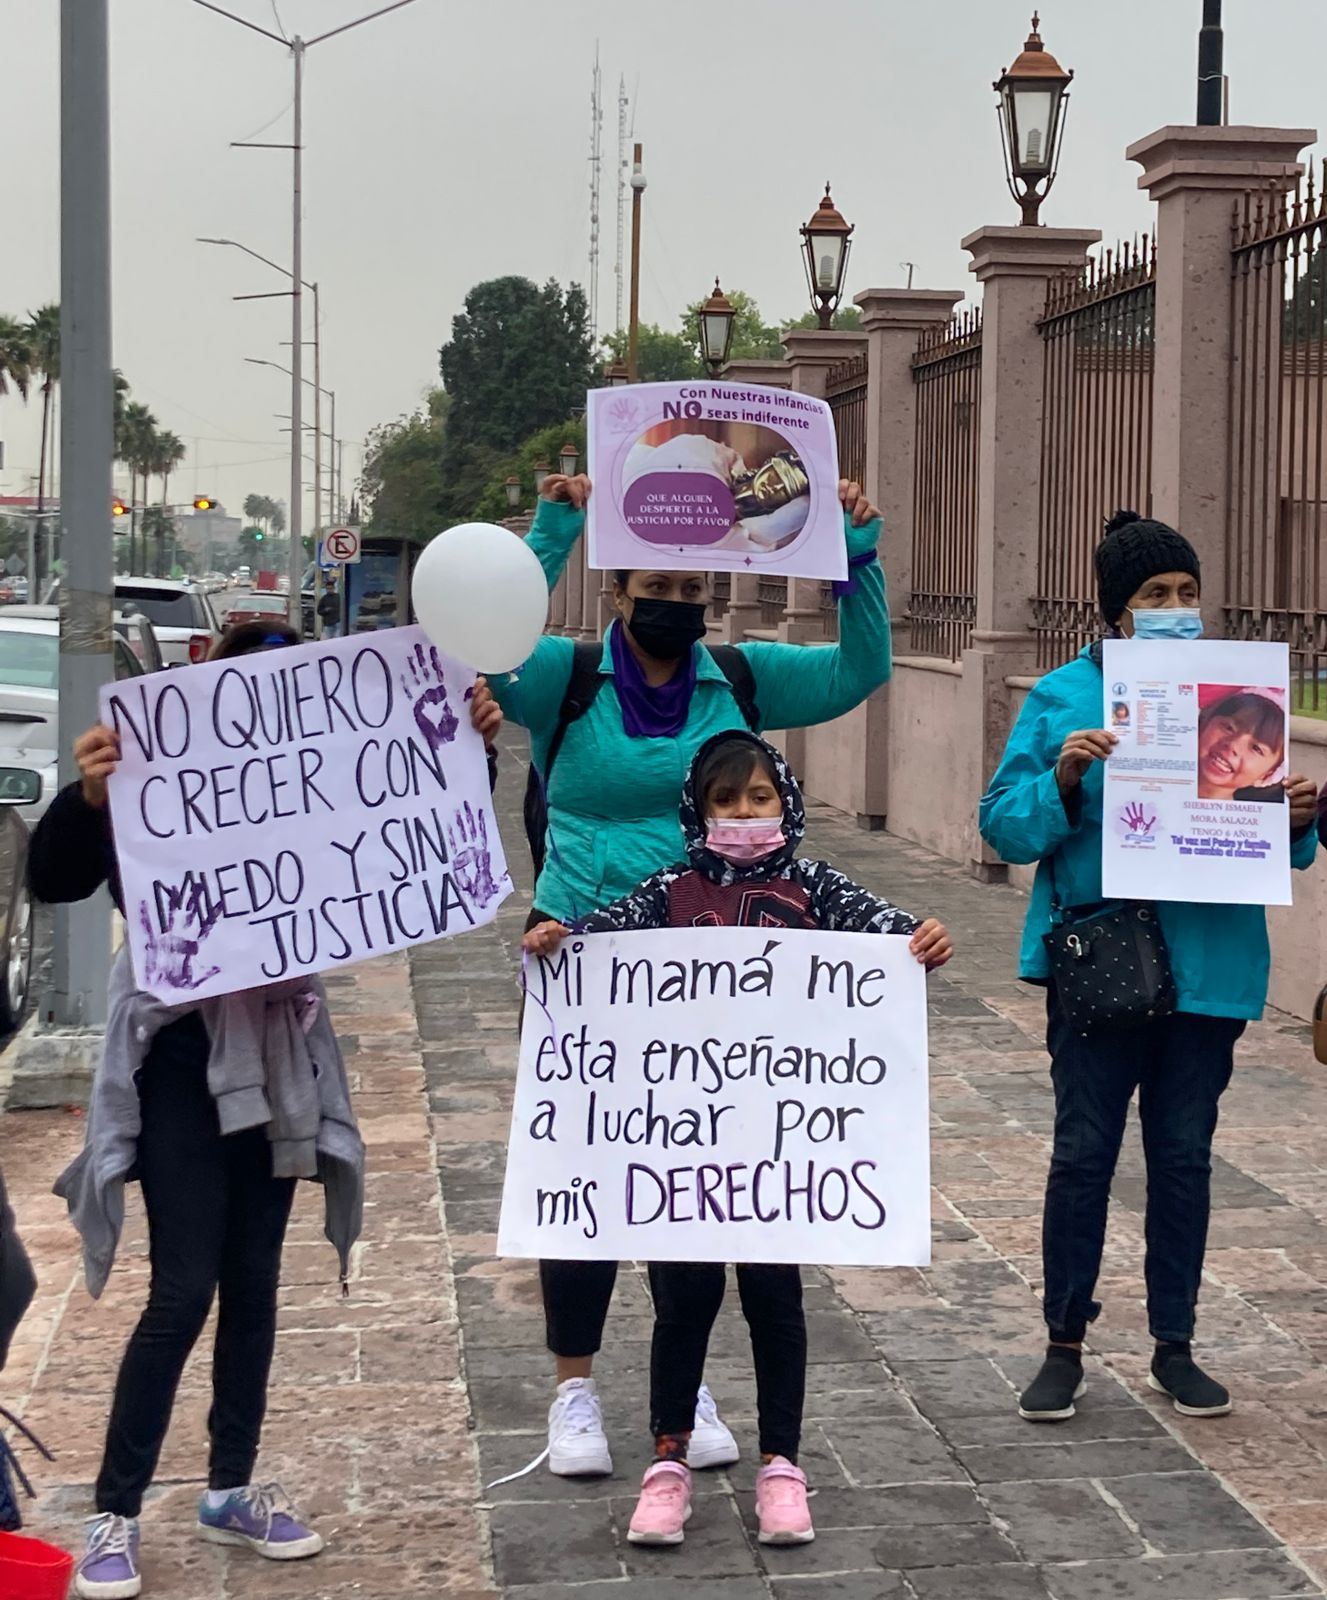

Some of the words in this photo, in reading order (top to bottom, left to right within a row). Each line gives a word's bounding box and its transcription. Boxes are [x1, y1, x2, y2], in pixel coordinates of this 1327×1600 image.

[663, 400, 703, 419] NO
[707, 409, 738, 420] seas
[741, 409, 810, 430] indiferente
[679, 388, 707, 399] Con
[711, 388, 771, 404] Nuestras
[627, 516, 671, 525] JUSTICIA
[674, 516, 694, 525] POR
[697, 518, 730, 527] FAVOR
[640, 505, 693, 514] DESPIERTE
[696, 506, 703, 514] A
[706, 506, 719, 514] LA
[646, 493, 667, 503] QUE
[671, 494, 713, 503] ALGUIEN
[109, 684, 191, 761] NO
[212, 648, 393, 750] QUIERO
[140, 748, 335, 838] CRECER
[355, 736, 448, 808] CON
[1183, 801, 1223, 811] SHERLYN
[1190, 814, 1218, 824] MORA
[1219, 816, 1259, 826] SALAZAR
[1191, 828, 1222, 837] TENGO
[152, 850, 304, 935] MIEDO
[331, 831, 366, 893] Y
[381, 808, 449, 882] SIN
[249, 873, 475, 978] JUSTICIA
[537, 941, 585, 1007] Mi
[610, 940, 781, 1007] mamá
[807, 954, 886, 1008] me
[535, 1025, 617, 1084] esta
[642, 1035, 887, 1094] enseñando
[529, 1100, 557, 1142] a
[587, 1088, 735, 1148] luchar
[774, 1099, 865, 1161] por
[536, 1177, 598, 1239] mis
[626, 1160, 887, 1230] DERECHOS
